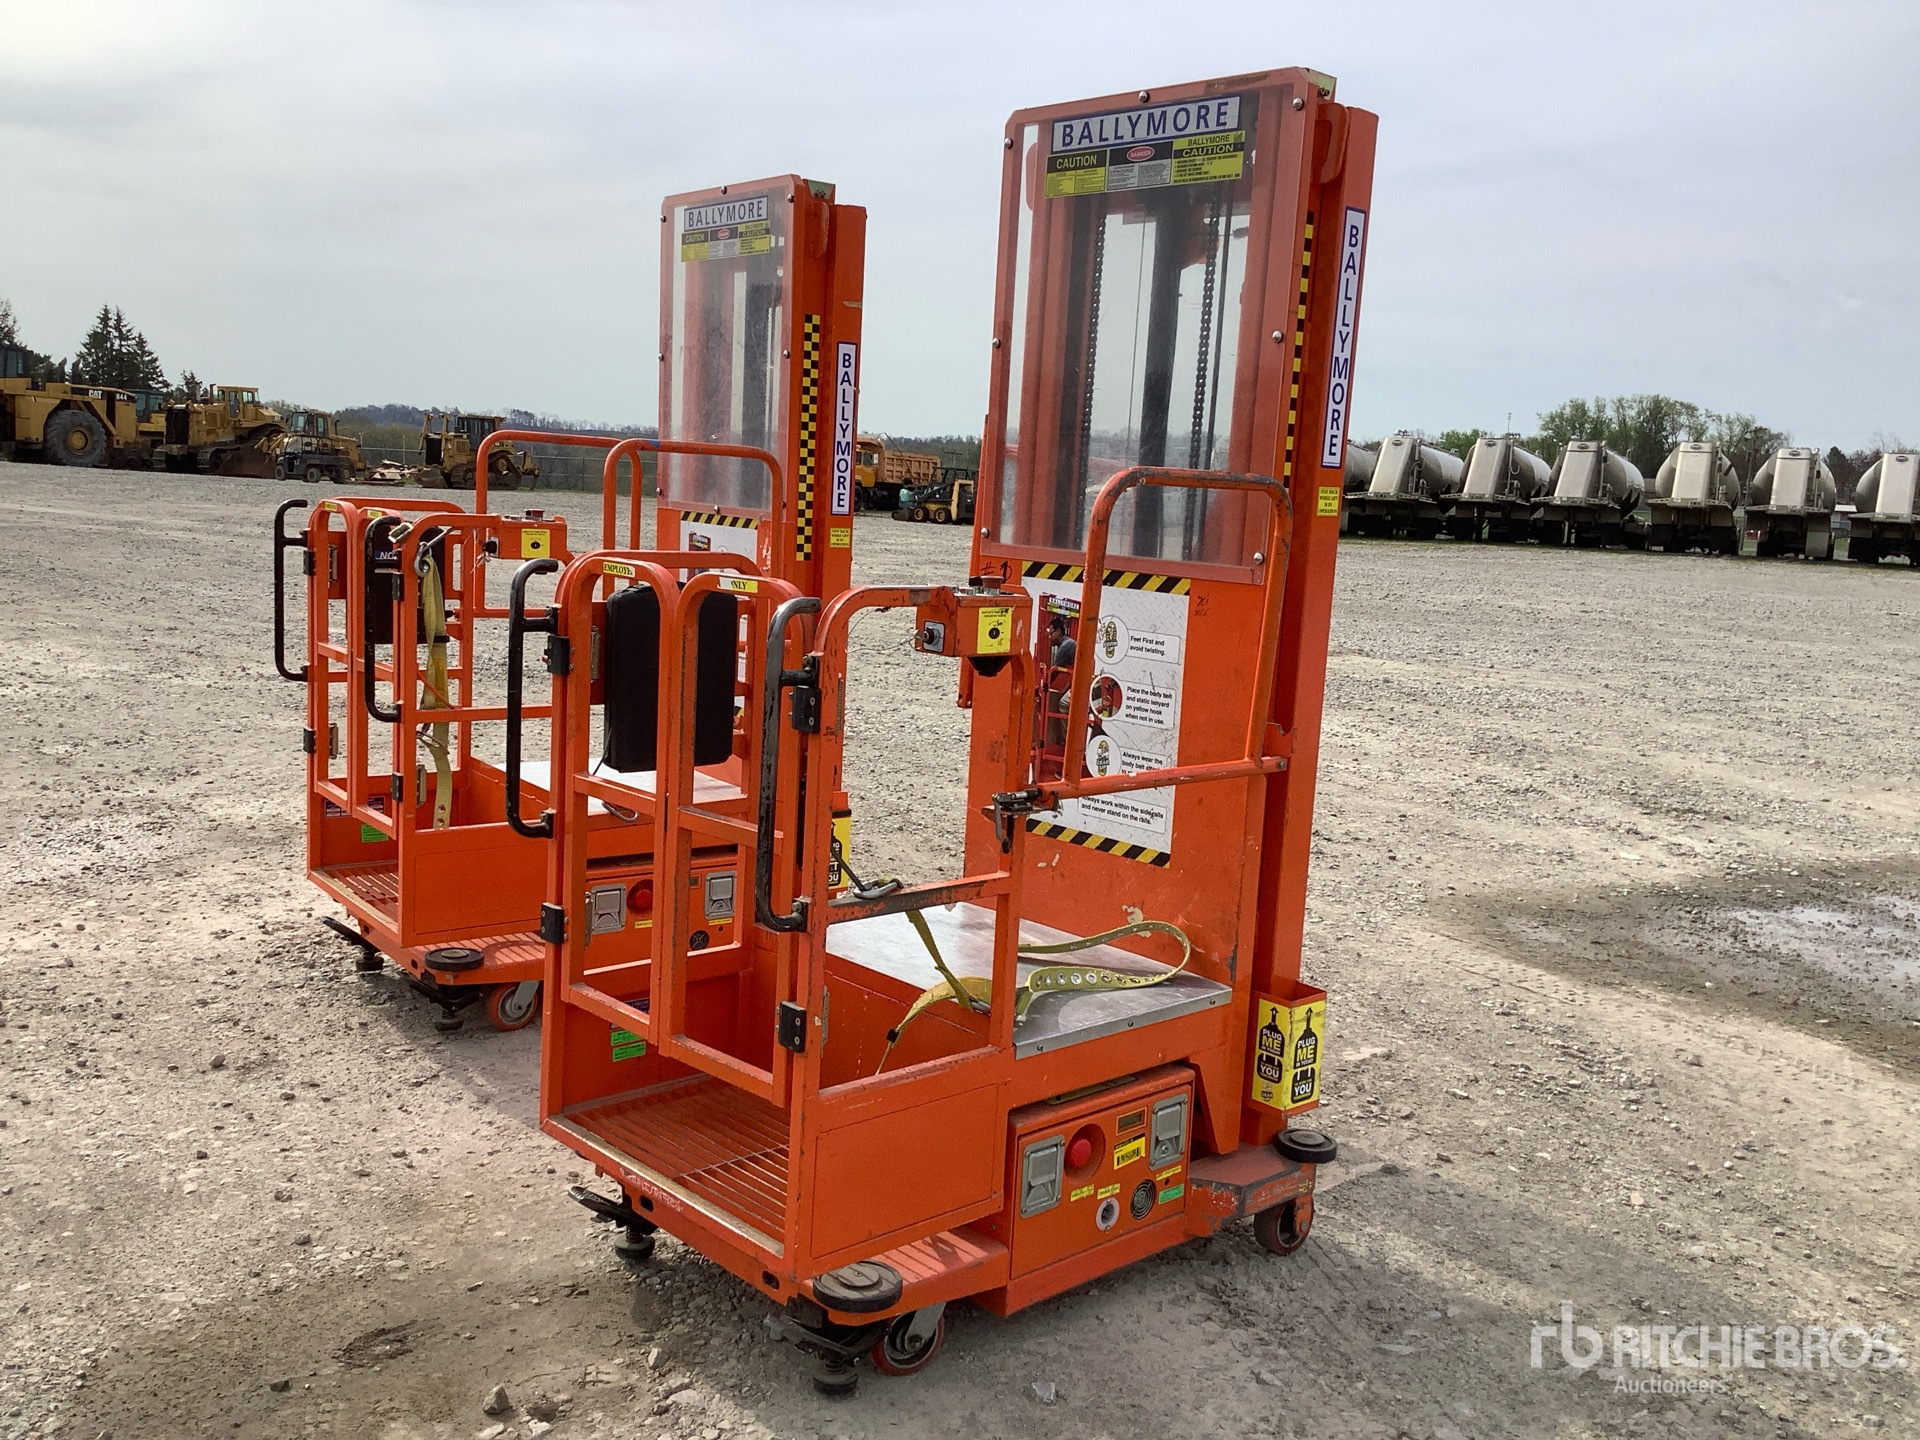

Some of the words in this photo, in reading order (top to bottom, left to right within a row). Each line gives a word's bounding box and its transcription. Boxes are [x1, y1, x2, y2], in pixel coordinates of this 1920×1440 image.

[1061, 101, 1229, 148] BALLYMORE
[1187, 134, 1231, 147] BALLYMORE
[1182, 144, 1234, 157] CAUTION
[1056, 154, 1097, 169] CAUTION
[687, 200, 763, 228] BALLYMORE
[1327, 224, 1358, 457] BALLYMORE
[88, 389, 103, 399] CAT
[836, 352, 852, 509] BALLYMORE
[1130, 635, 1142, 643] Feet
[1142, 637, 1154, 645] First
[1127, 686, 1141, 694] Place
[1149, 690, 1162, 699] body
[1136, 697, 1150, 705] static
[1133, 705, 1149, 713] yellow
[1149, 708, 1163, 716] hook
[1121, 760, 1135, 769] body
[1135, 762, 1146, 770] belt
[1122, 751, 1141, 761] Always
[1153, 757, 1163, 765] the
[1100, 799, 1114, 807] work
[1114, 802, 1130, 811] within
[1130, 805, 1140, 813] the
[1091, 805, 1106, 813] never
[1106, 808, 1121, 817] stand
[1129, 814, 1139, 822] the
[1262, 1028, 1283, 1041] PLUG
[1262, 1035, 1282, 1051] ME
[1297, 1036, 1316, 1049] PLUG
[1296, 1044, 1315, 1062] ME
[1260, 1064, 1279, 1078] YOU
[1294, 1082, 1312, 1096] YOU
